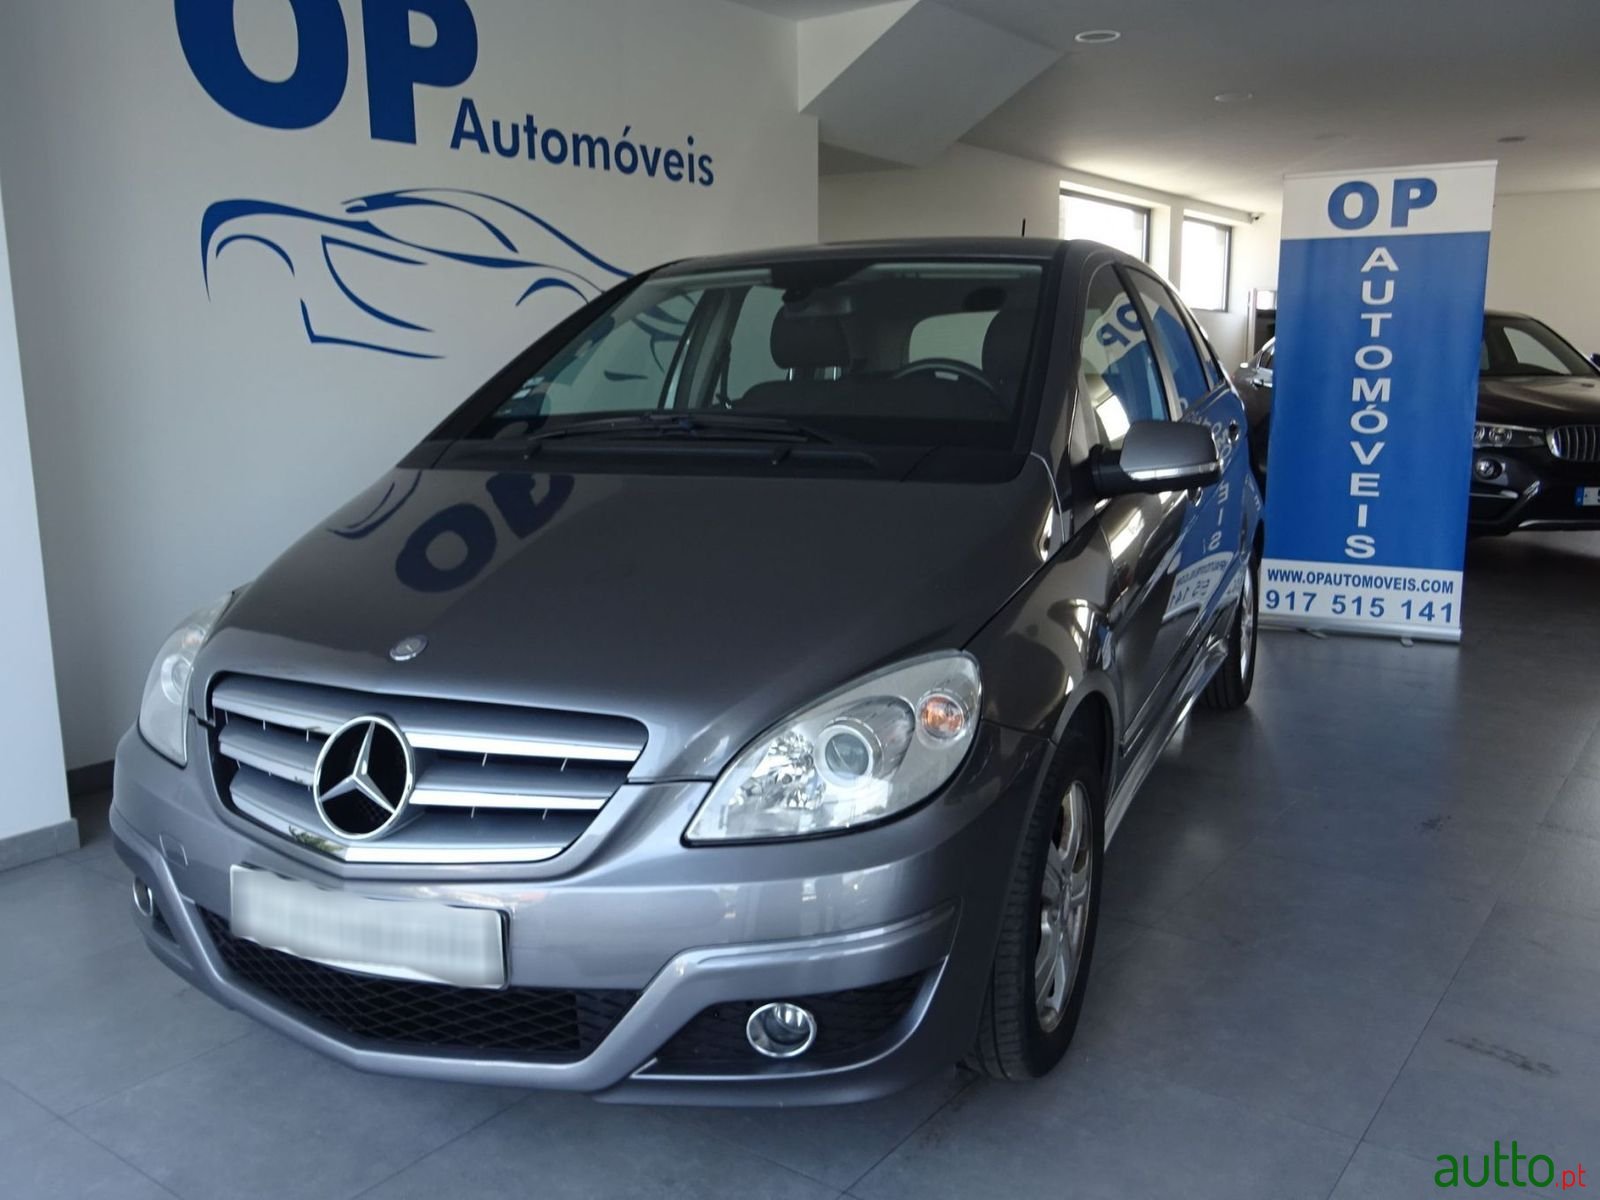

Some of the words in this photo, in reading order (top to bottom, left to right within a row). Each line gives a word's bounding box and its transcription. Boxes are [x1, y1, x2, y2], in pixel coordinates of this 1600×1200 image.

[173, 0, 478, 144] OP
[450, 97, 714, 187] Automóveis
[1328, 177, 1437, 230] OP
[1344, 247, 1399, 559] AUTOMÓVEIS
[1265, 589, 1317, 612] 917
[1331, 594, 1385, 618] 515
[1401, 600, 1452, 623] 141
[1267, 569, 1453, 594] WWW.OPAUTOMOVEIS.COM
